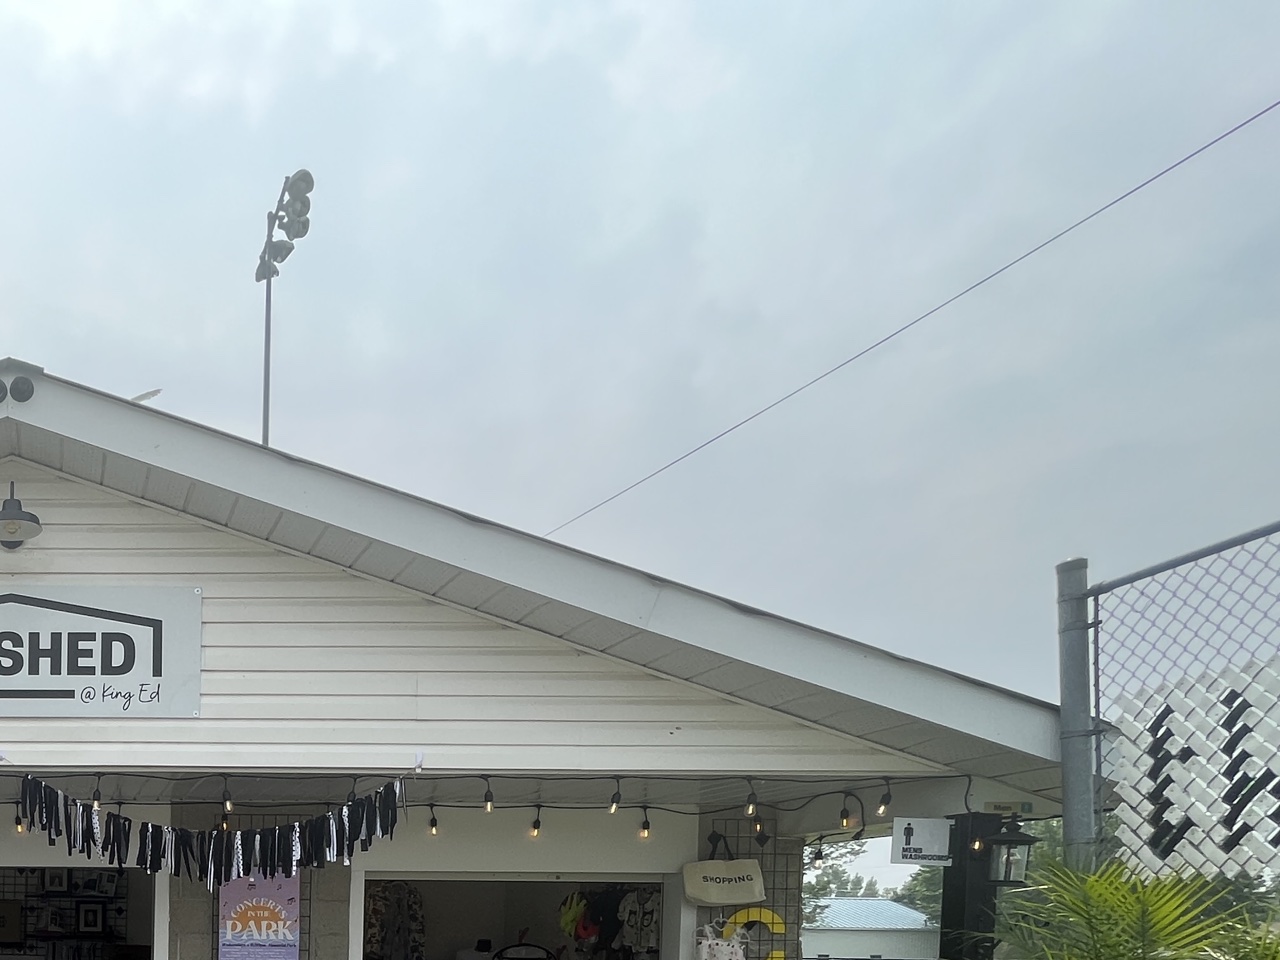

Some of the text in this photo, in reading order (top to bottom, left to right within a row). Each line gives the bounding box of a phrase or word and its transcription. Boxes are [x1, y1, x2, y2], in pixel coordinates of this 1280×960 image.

[80, 683, 160, 711] @ King Ed
[702, 874, 753, 884] SHOPPING
[231, 897, 288, 919] CONCERTS
[225, 920, 294, 939] PARK
